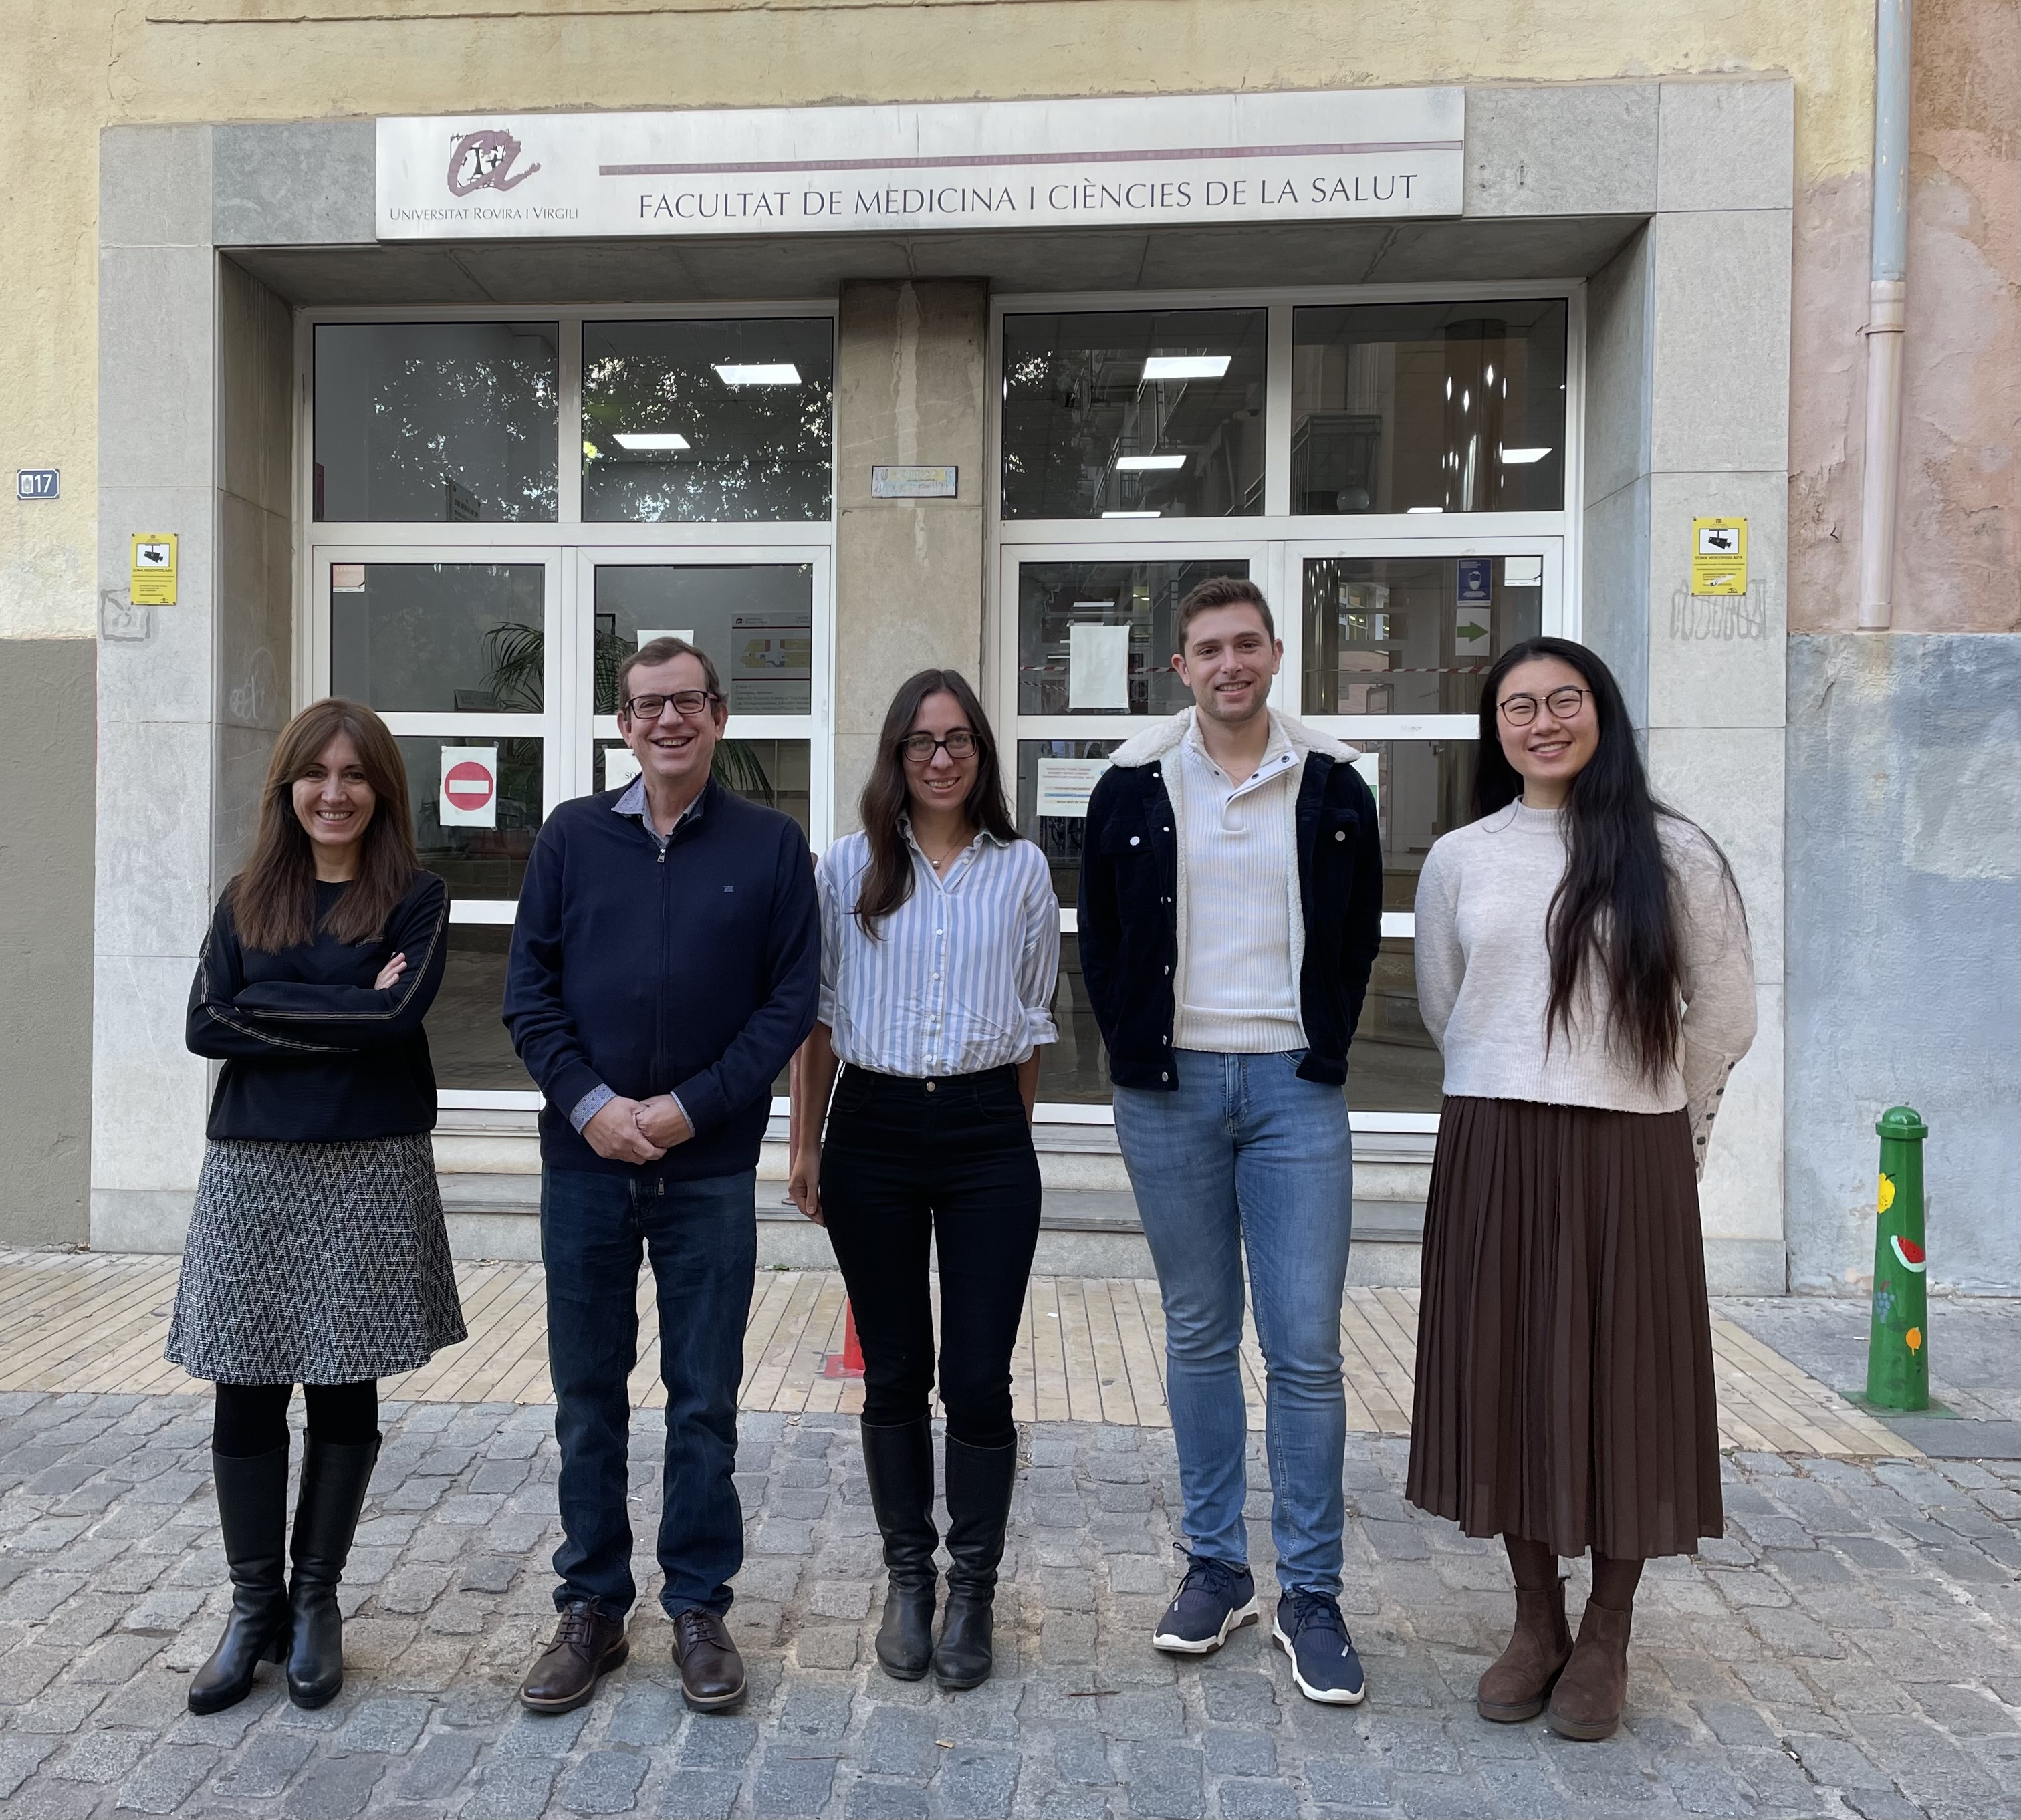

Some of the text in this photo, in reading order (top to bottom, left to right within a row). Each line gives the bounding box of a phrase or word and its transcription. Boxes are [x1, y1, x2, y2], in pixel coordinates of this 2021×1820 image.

[640, 174, 1418, 219] FACULTAT DE MEDICINA I CIÈNCIES DE LA SALUT
[389, 207, 579, 221] UNIVERSITAT ROVIRA I VIRGILI
[34, 473, 53, 493] 17
